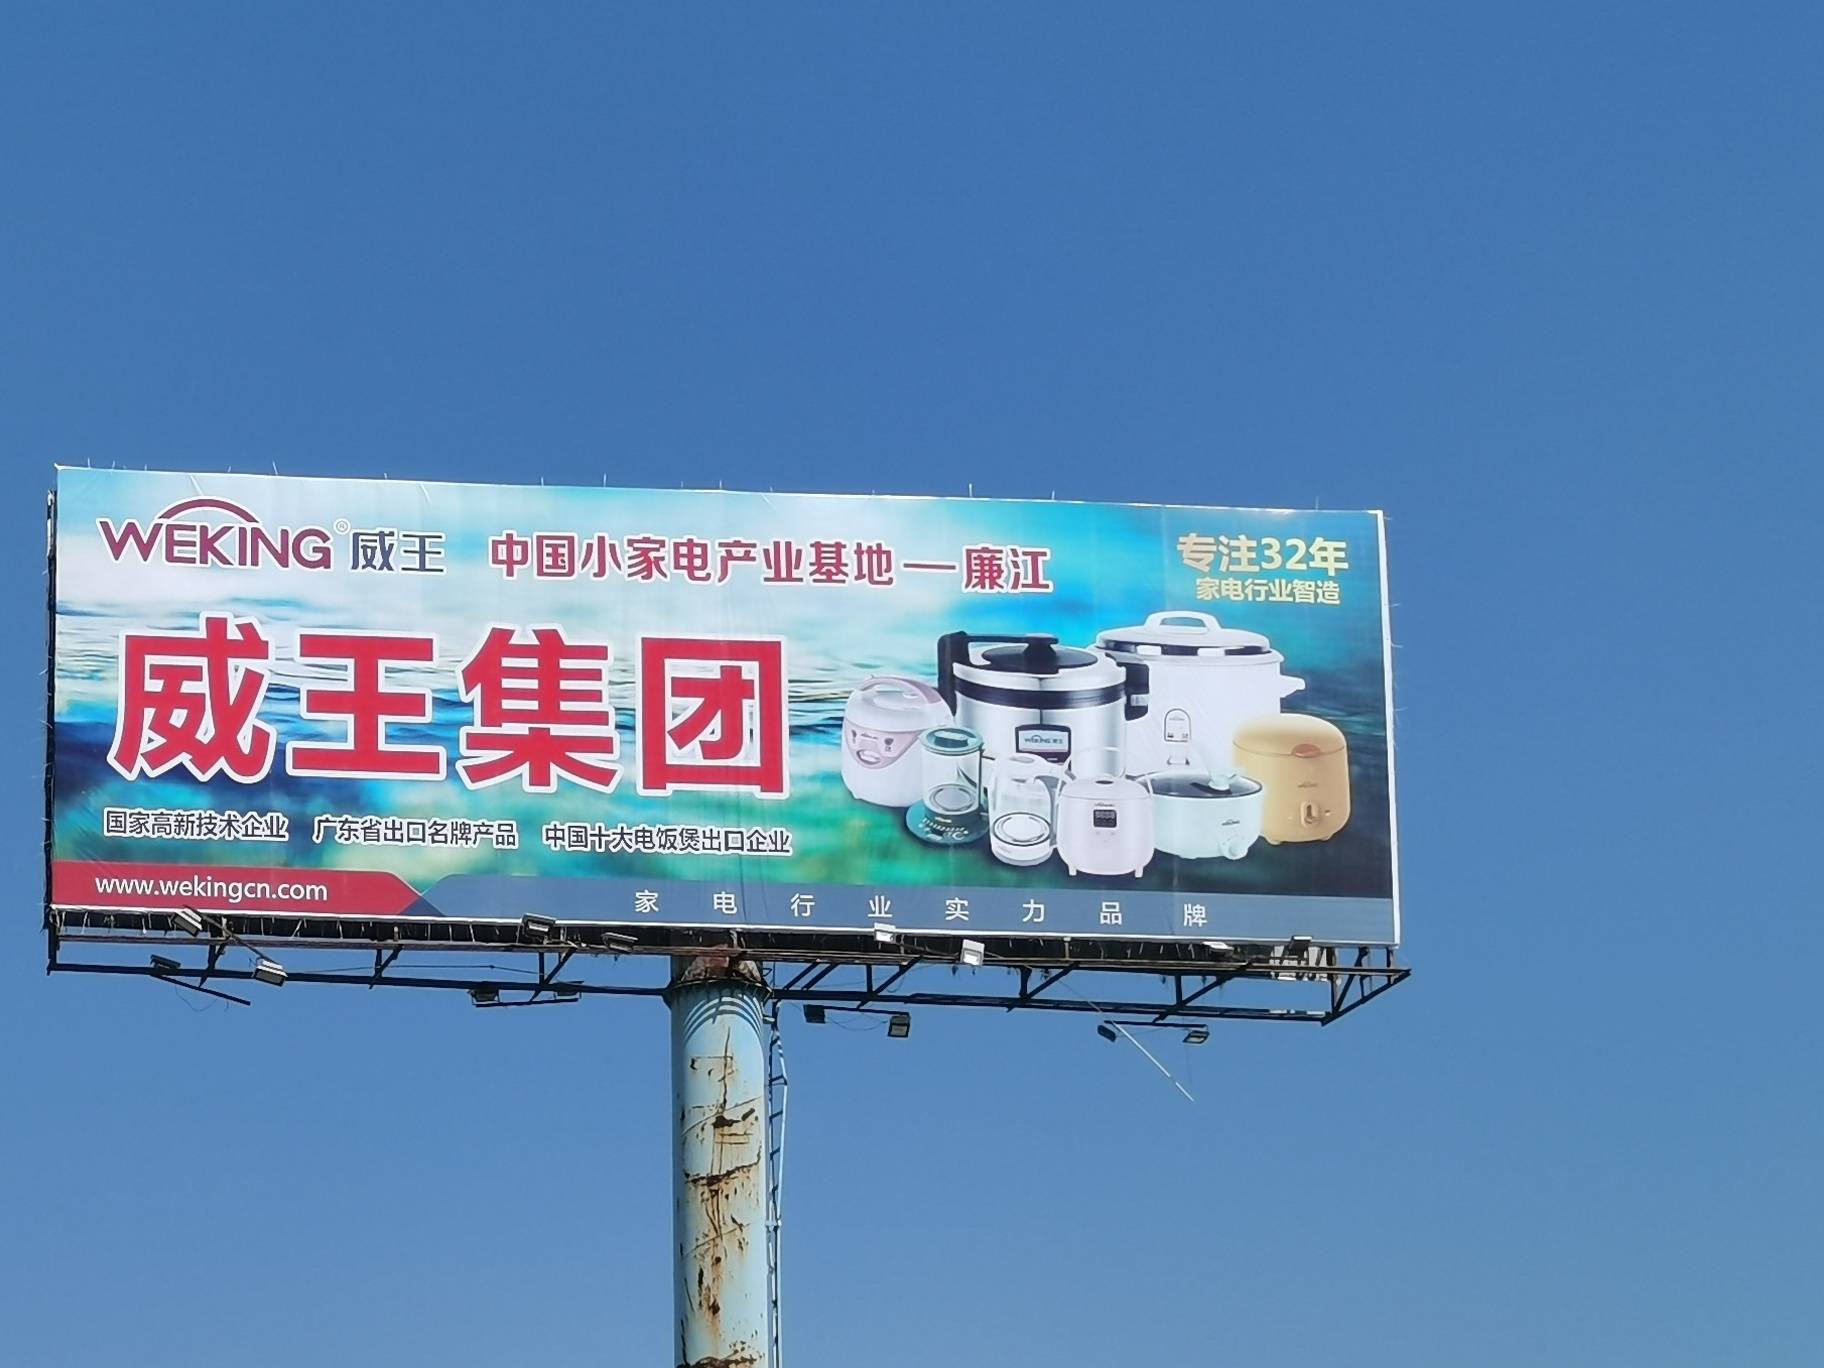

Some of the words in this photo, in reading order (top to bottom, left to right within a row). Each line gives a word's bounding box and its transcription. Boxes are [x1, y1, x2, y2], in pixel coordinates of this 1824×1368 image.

[349, 530, 446, 573] 威王
[1177, 533, 1349, 577] 专注32年
[1196, 577, 1341, 605] 家电行业智造
[112, 616, 786, 795] 威王集团
[105, 810, 287, 840] 国家高新技术企业
[314, 816, 517, 847] 广东省出口名牌产品
[544, 823, 791, 854] 中国十大电饭煲出口企业
[94, 874, 328, 903] www.wekingcn.com
